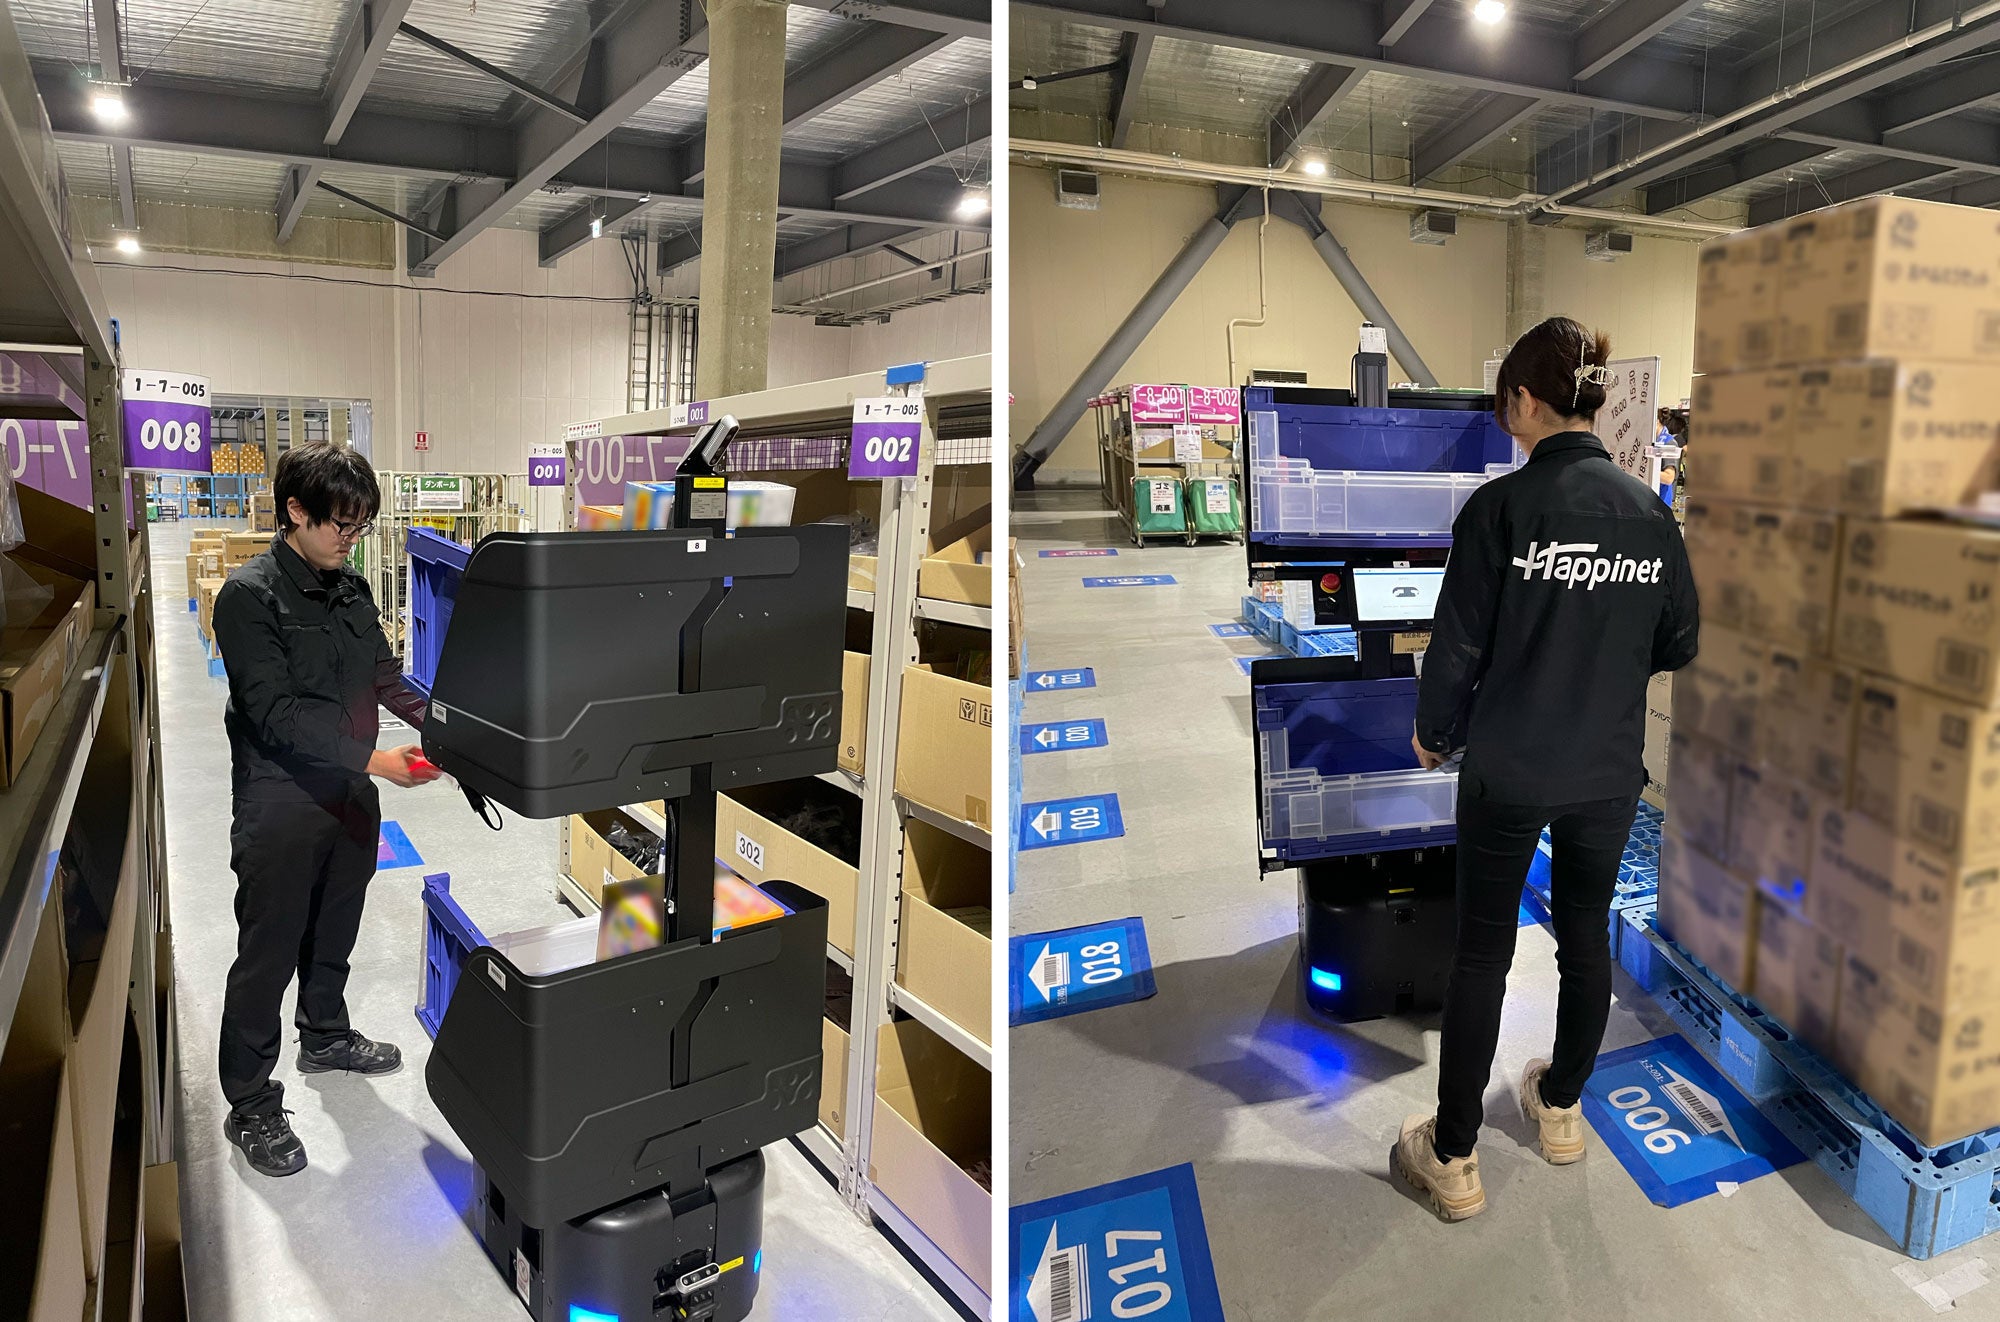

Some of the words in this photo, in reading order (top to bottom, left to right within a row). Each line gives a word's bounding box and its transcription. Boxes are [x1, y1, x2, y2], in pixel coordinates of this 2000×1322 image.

[135, 377, 205, 397] 1-7-005
[1133, 387, 1184, 405] 1-8-001
[1629, 370, 1637, 402] 15:30
[1641, 372, 1650, 404] 19:30
[1189, 387, 1238, 407] 1-8-002
[690, 407, 704, 421] 001
[865, 404, 919, 416] 1-7-005
[1611, 398, 1627, 419] 18:00
[140, 418, 201, 453] 008
[1616, 418, 1631, 442] 19:00
[533, 446, 563, 455] 1-7-005
[864, 436, 913, 462] 002
[533, 464, 560, 479] 001
[424, 480, 456, 489] ダンボール
[1155, 482, 1170, 490] ゴミ
[694, 542, 700, 550] 8
[1512, 541, 1663, 590] Happinet
[1065, 726, 1090, 742] 020
[1069, 806, 1101, 830] 019
[739, 837, 761, 866] 302
[1080, 941, 1123, 984] 018
[1607, 1085, 1692, 1155] 006
[1105, 1230, 1172, 1319] 017
